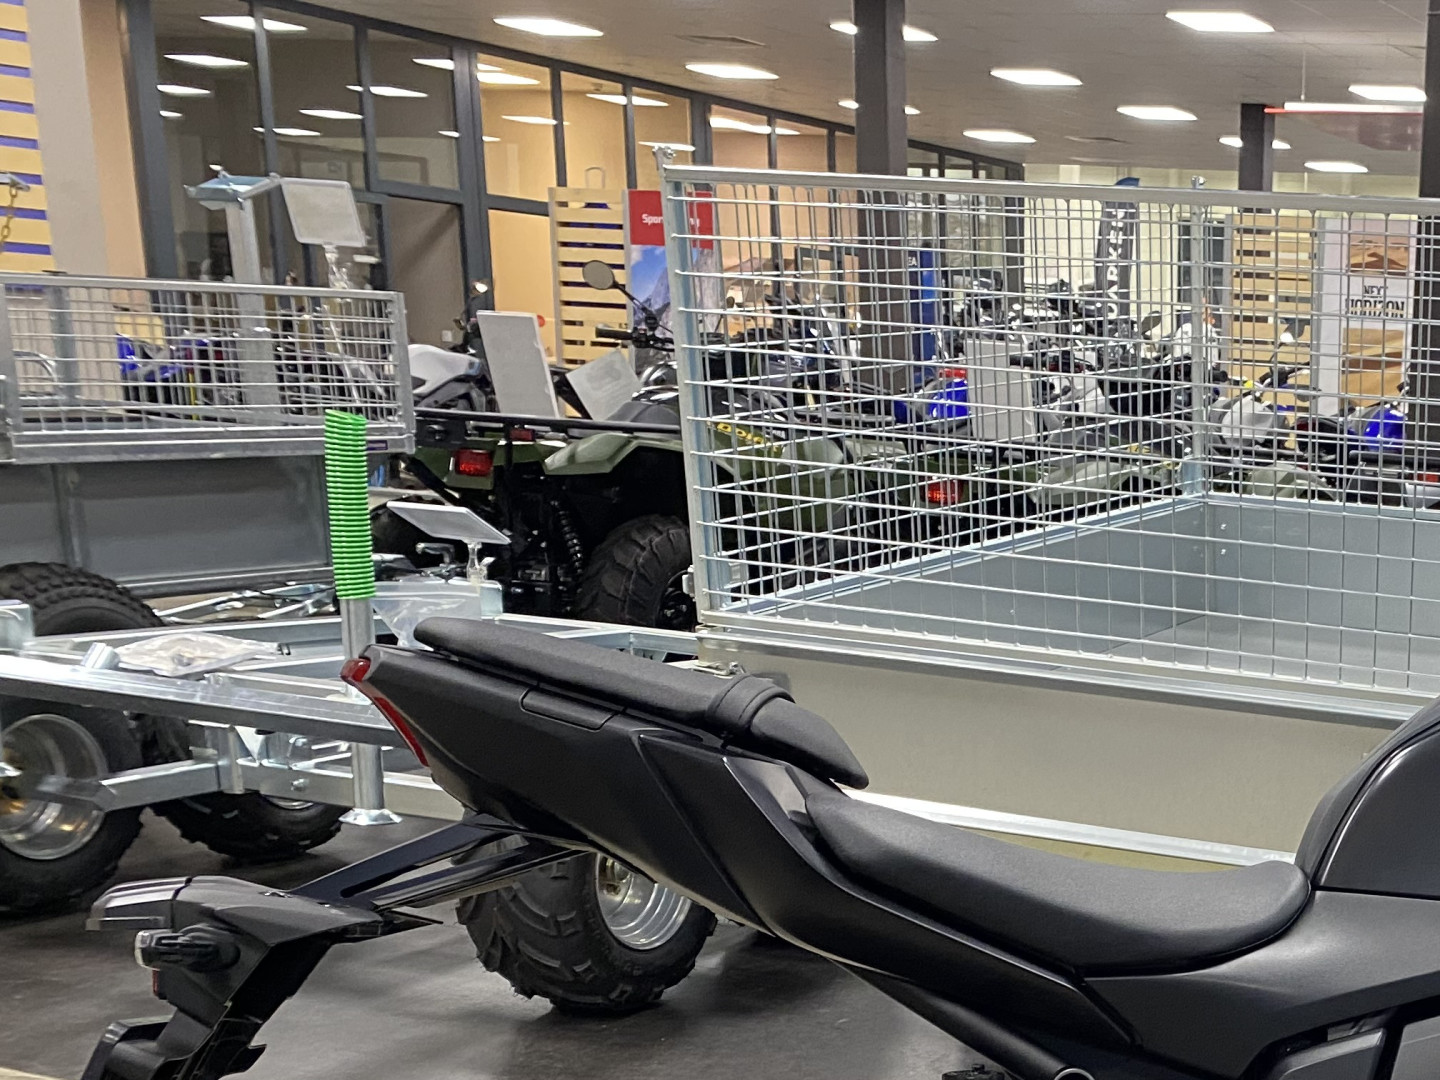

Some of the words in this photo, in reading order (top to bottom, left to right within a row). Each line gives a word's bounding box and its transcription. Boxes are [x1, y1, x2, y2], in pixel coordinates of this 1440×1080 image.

[641, 213, 665, 226] Spor
[1363, 285, 1388, 298] NEXT
[1345, 298, 1405, 318] HORIZON
